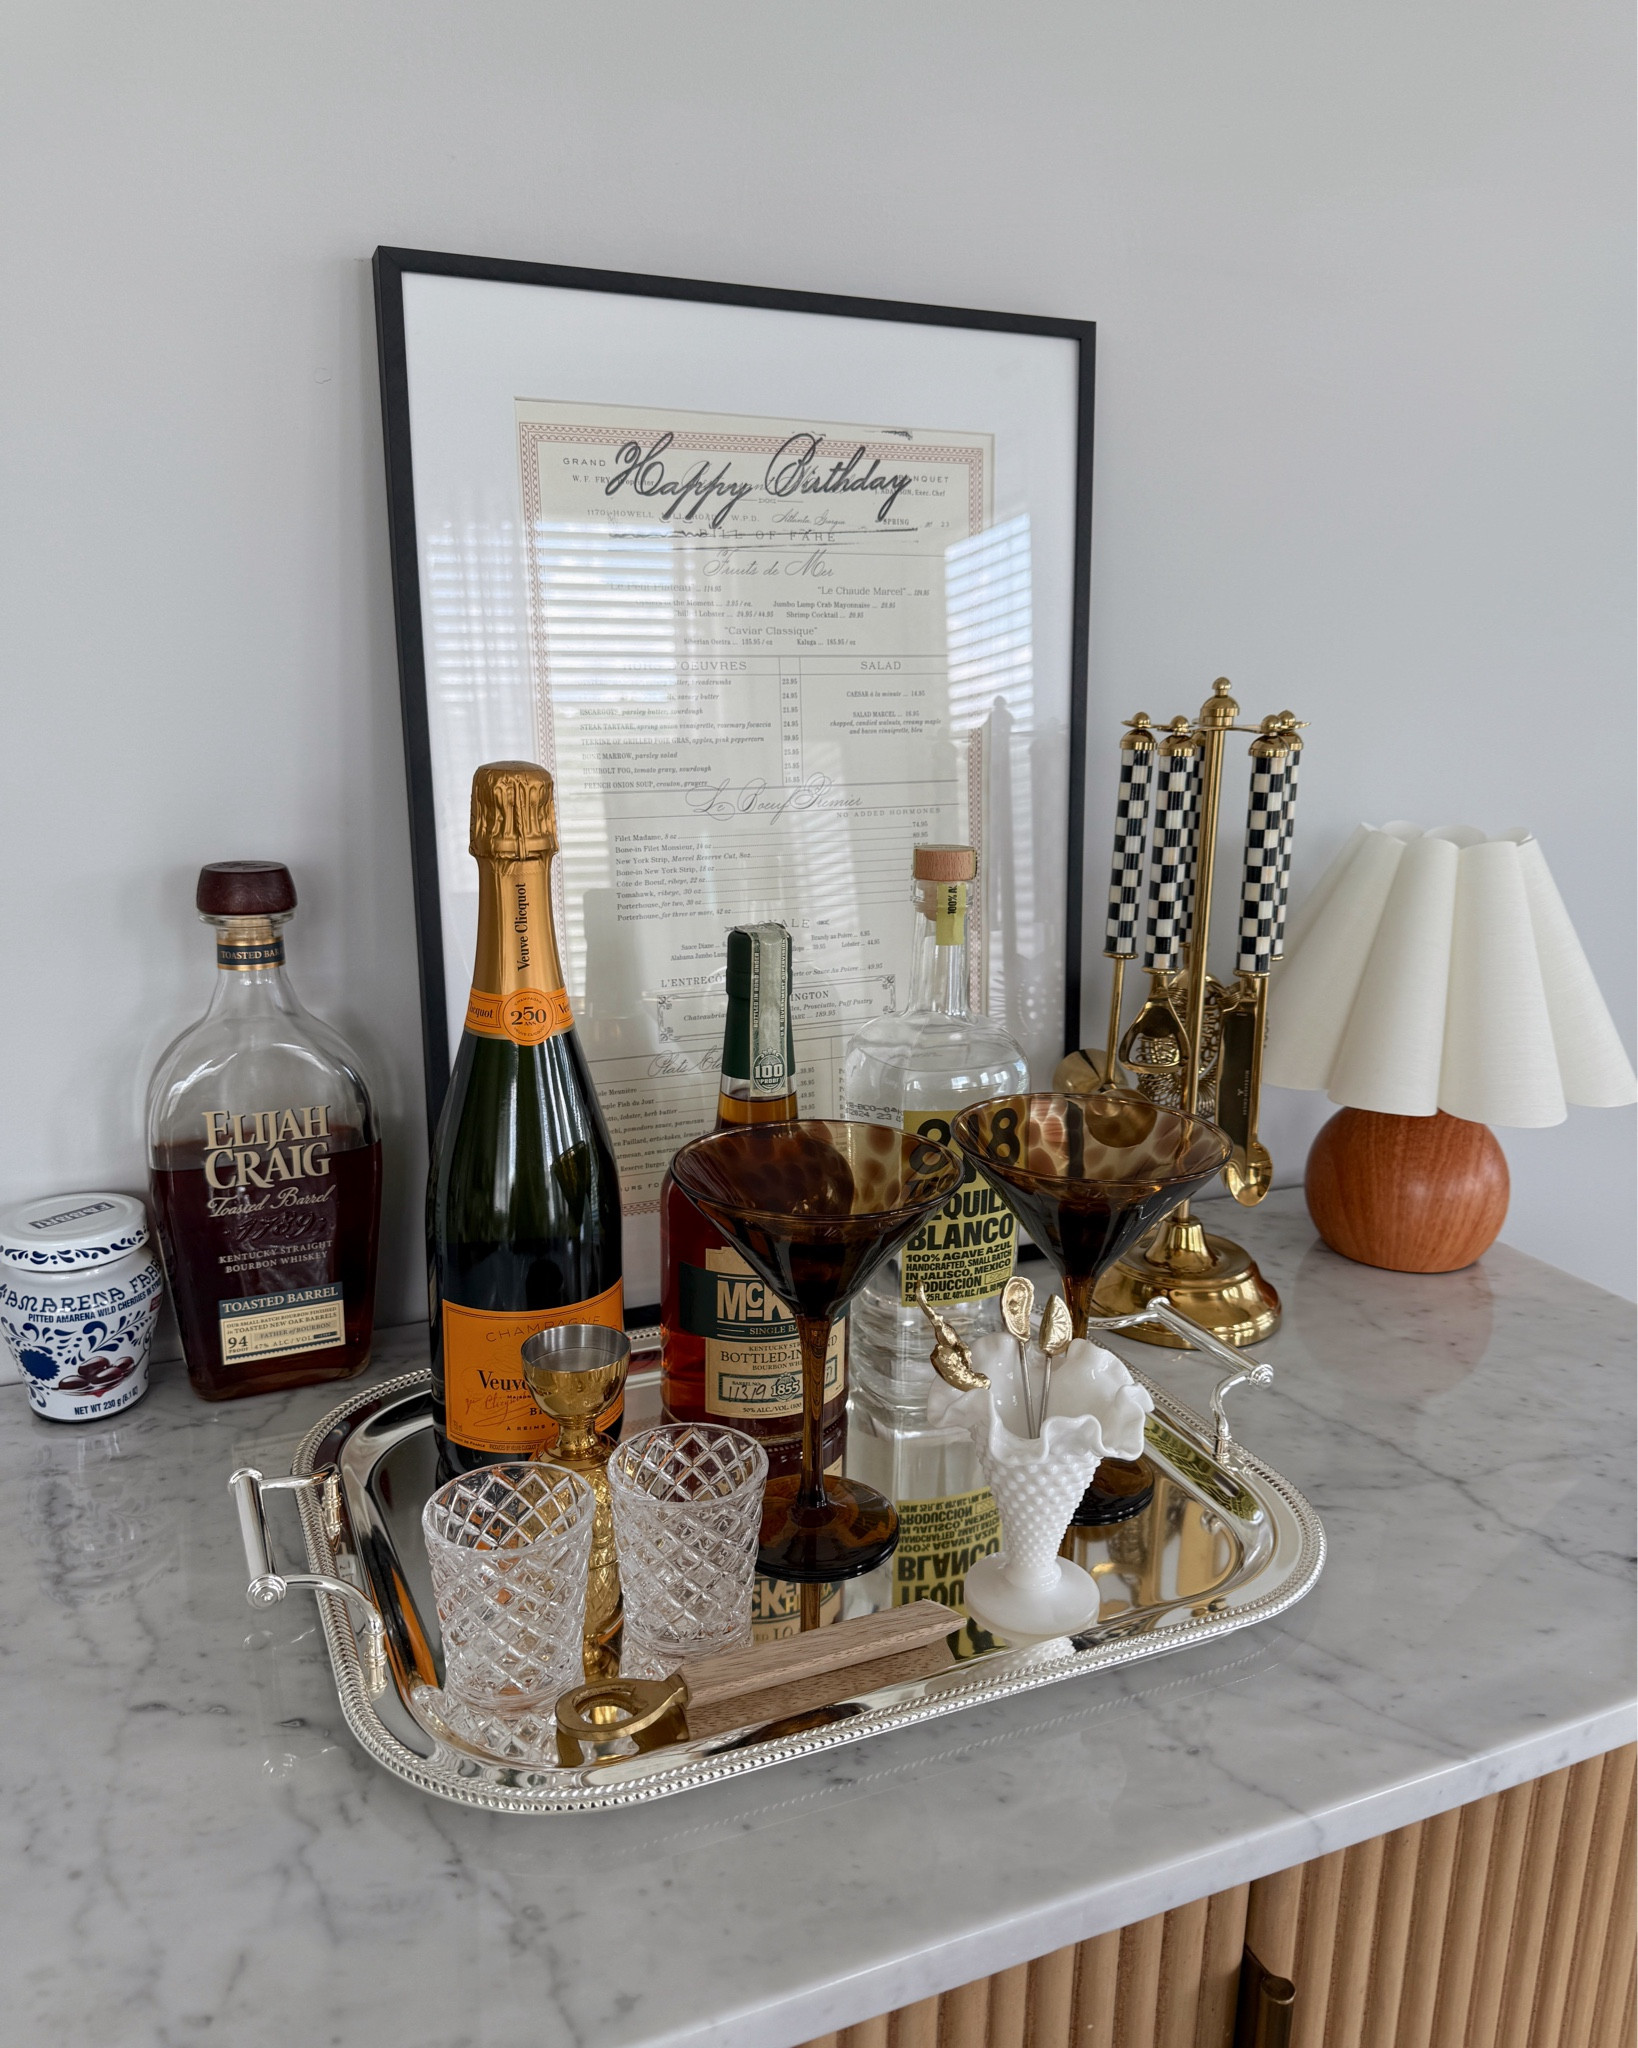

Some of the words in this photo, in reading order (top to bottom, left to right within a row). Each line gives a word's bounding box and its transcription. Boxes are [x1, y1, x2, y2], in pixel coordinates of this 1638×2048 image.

[562, 457, 606, 467] GRAND
[605, 431, 754, 529] Happy
[765, 432, 912, 521] Birthday
[755, 530, 777, 541] OF
[790, 531, 836, 543] FARE
[763, 560, 779, 577] de
[835, 585, 871, 596] Chaude
[773, 601, 795, 609] Jumbo
[797, 601, 816, 610] Lump
[834, 602, 870, 611] Mayonnaise
[786, 611, 810, 621] Shrimp
[811, 611, 839, 620] Cocktail
[724, 626, 762, 635] "Caviar
[766, 626, 817, 638] Classique"
[860, 660, 901, 671] SALAD
[872, 710, 896, 718] MARCEL
[855, 719, 878, 727] candied
[903, 718, 924, 727] creamy
[854, 810, 885, 818] ADDED
[889, 807, 941, 816] HORMONES
[615, 834, 631, 842] Filet
[616, 858, 631, 866] New
[632, 857, 650, 865] York
[650, 856, 670, 865] Strip,
[644, 867, 660, 875] New
[661, 867, 678, 875] York
[616, 891, 656, 900] Tomahawk,
[514, 883, 529, 935] Clicquot
[947, 895, 958, 914] 100%
[221, 951, 262, 960] TOASTED
[517, 935, 531, 972] Veuve
[510, 1006, 547, 1026] 250
[755, 1063, 784, 1079] 100
[202, 1105, 331, 1151] ELIJAH
[205, 1142, 331, 1189] CRAIG
[207, 1194, 271, 1218] Toasted
[270, 1184, 336, 1209] Barrel
[931, 1188, 1007, 1221] QUIL
[907, 1212, 1014, 1252] BLANCO
[218, 1249, 277, 1264] KENTUCKY
[280, 1239, 333, 1255] STRAIGHT
[906, 1253, 940, 1263] 100%
[941, 1248, 984, 1261] AGAVE
[986, 1241, 1012, 1255] AZUL
[225, 1259, 277, 1274] BOURBON
[280, 1250, 328, 1265] WHISKEY
[906, 1260, 966, 1272] HANDCRAFTED,
[968, 1256, 992, 1267] SMALL
[992, 1249, 1012, 1262] BATCH
[906, 1272, 919, 1281] IN
[920, 1268, 973, 1281] JALISCO,
[974, 1258, 1011, 1275] MEXICO
[28, 1313, 54, 1324] PITTED
[56, 1311, 96, 1324] AMARENA
[97, 1304, 116, 1318] WILD
[118, 1290, 147, 1312] CHERRIES
[222, 1295, 285, 1314] TOASTED
[287, 1286, 339, 1304] BARREL
[234, 1324, 269, 1335] TOASTED
[270, 1320, 288, 1328] NEW
[288, 1317, 304, 1326] OAK
[305, 1312, 338, 1323] BARRELS
[240, 1319, 259, 1327] SMALL
[260, 1316, 280, 1324] BATCH
[281, 1311, 309, 1320] BOURBON
[309, 1306, 337, 1315] FINISHED
[260, 1330, 289, 1340] FATHER
[288, 1327, 297, 1335] of
[296, 1321, 332, 1333] BOURBON
[749, 1323, 786, 1335] SINGLE
[228, 1335, 249, 1349] 94
[228, 1346, 249, 1354] PROOF
[748, 1343, 787, 1352] KENTUCKY
[752, 1363, 788, 1371] BOURBON
[771, 1381, 800, 1397] 1855
[74, 1405, 89, 1416] NET
[90, 1403, 102, 1414] WT
[103, 1399, 116, 1411] 230
